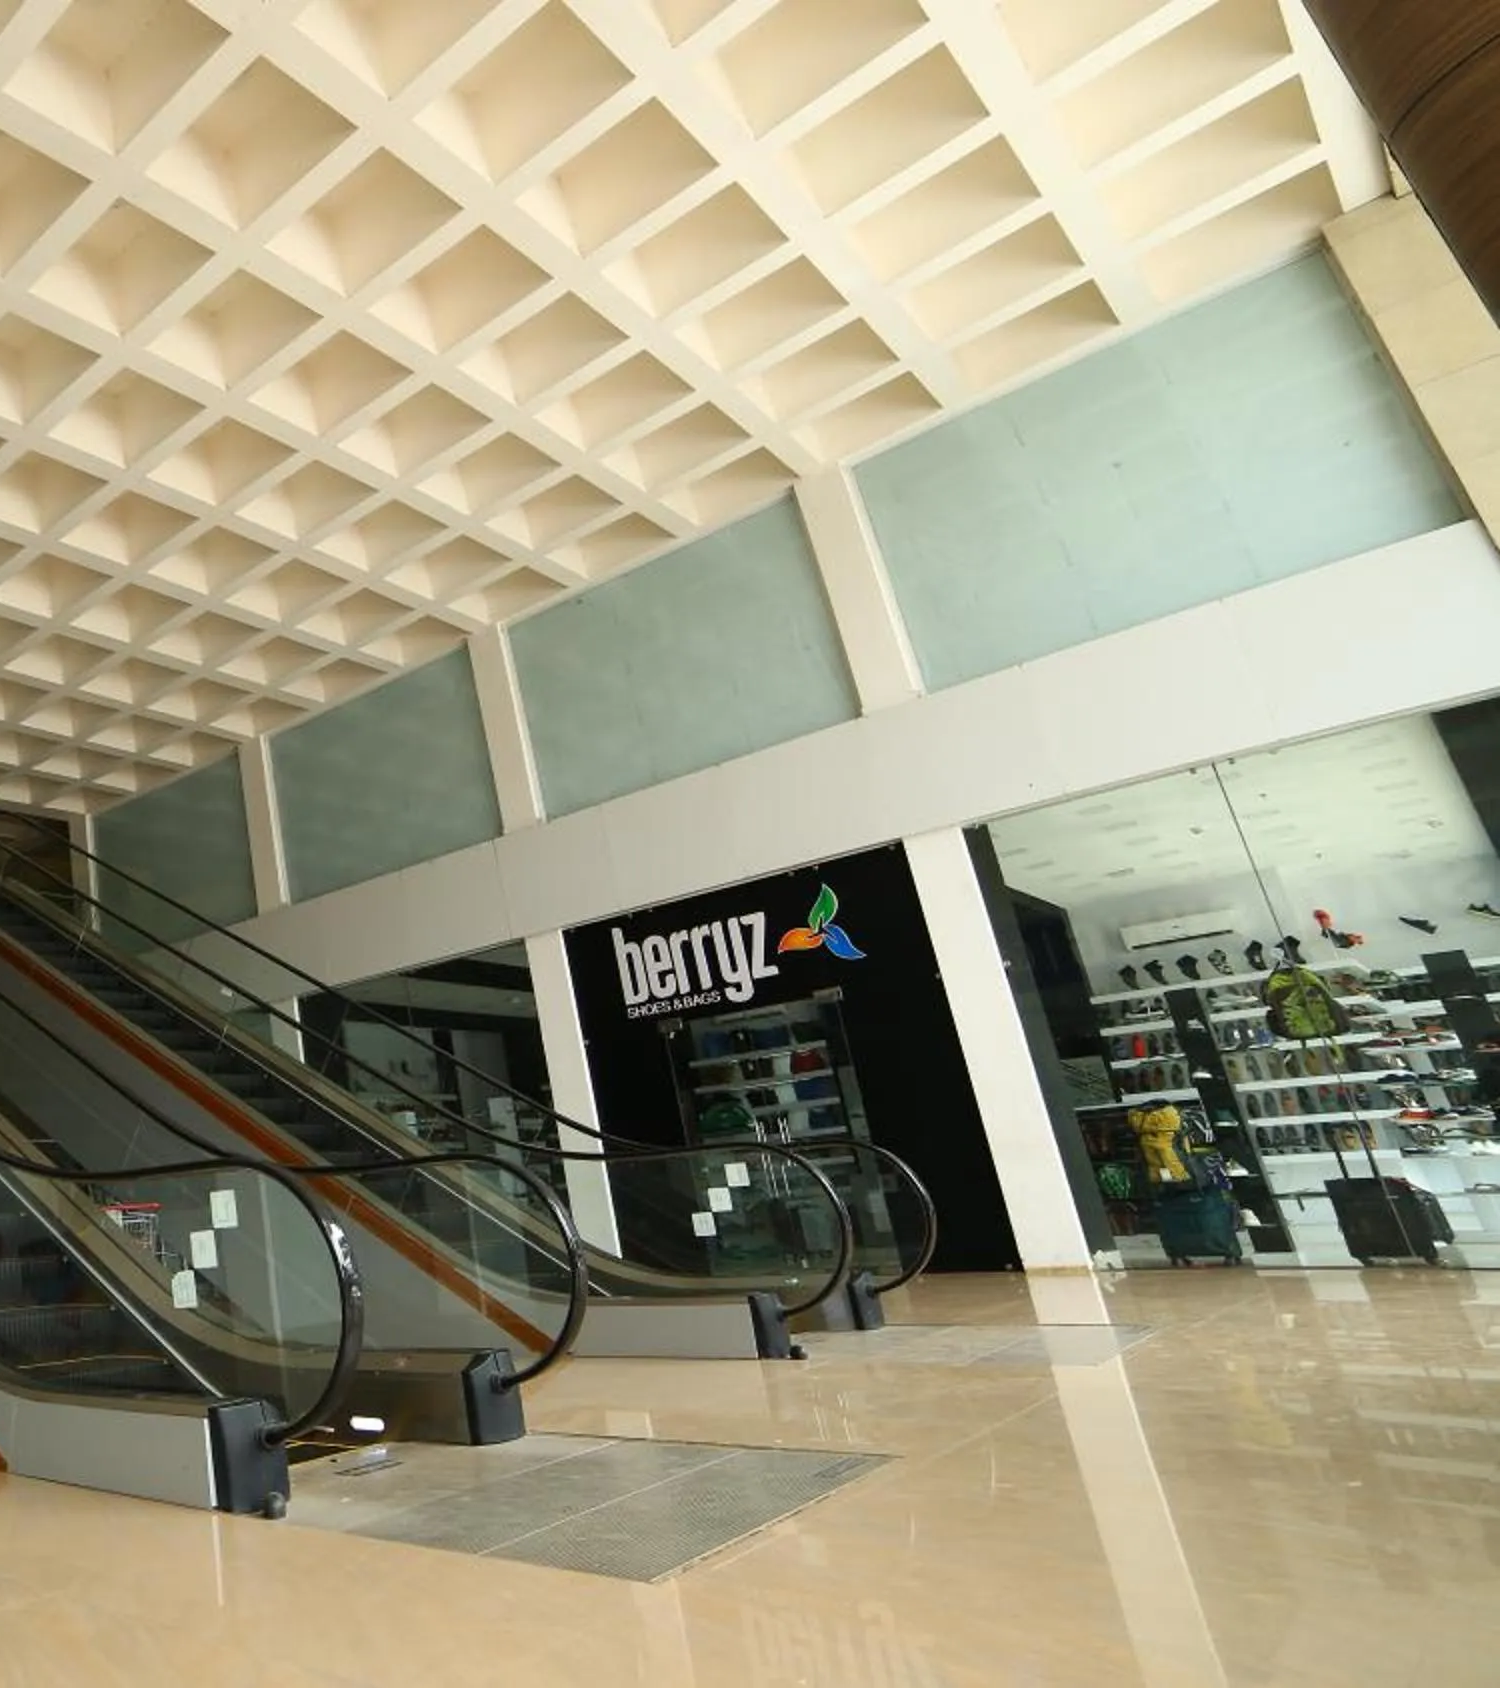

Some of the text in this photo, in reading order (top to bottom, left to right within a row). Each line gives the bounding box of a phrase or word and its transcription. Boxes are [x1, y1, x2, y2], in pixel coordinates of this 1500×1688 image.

[611, 911, 780, 1003] berryz
[627, 1001, 671, 1019] SHOES
[683, 990, 721, 1009] BAGS
